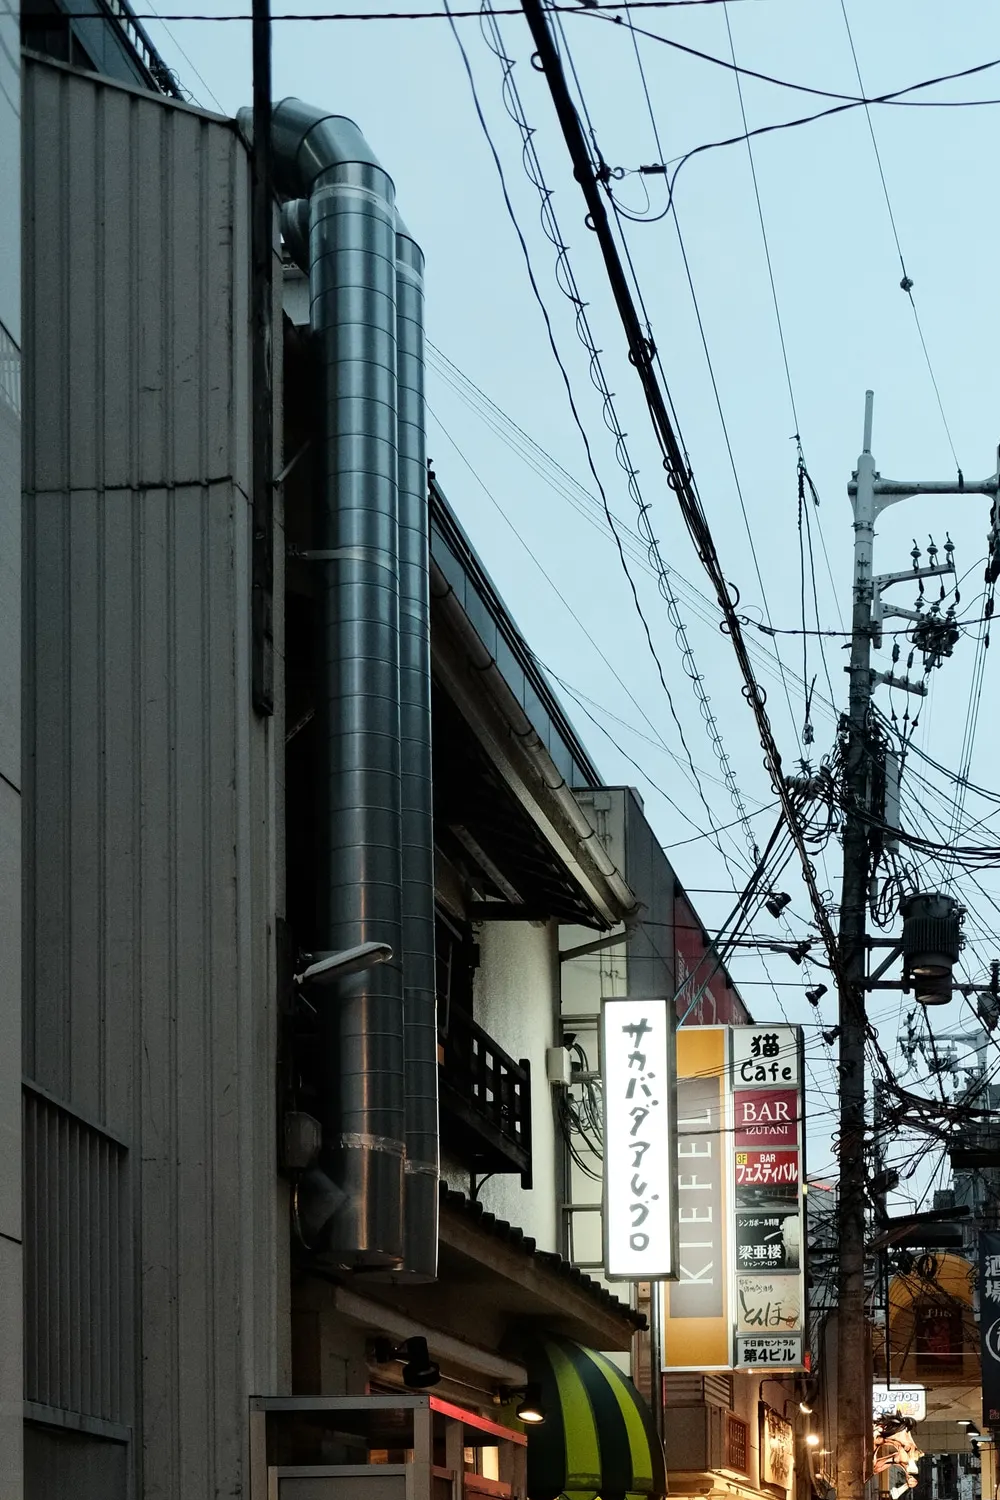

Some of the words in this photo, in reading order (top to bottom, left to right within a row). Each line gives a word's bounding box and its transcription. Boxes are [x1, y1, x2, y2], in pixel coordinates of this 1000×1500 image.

[750, 1032, 780, 1058] 猫
[740, 1059, 792, 1082] Cafe
[741, 1101, 790, 1122] BAR
[736, 1154, 747, 1164] 3F
[759, 1153, 776, 1163] BAR
[736, 1163, 799, 1184] フェスティバル
[677, 1107, 713, 1285] KIEFEL
[743, 1339, 796, 1347] 千日前セントラル
[743, 1348, 796, 1363] 第4ビル
